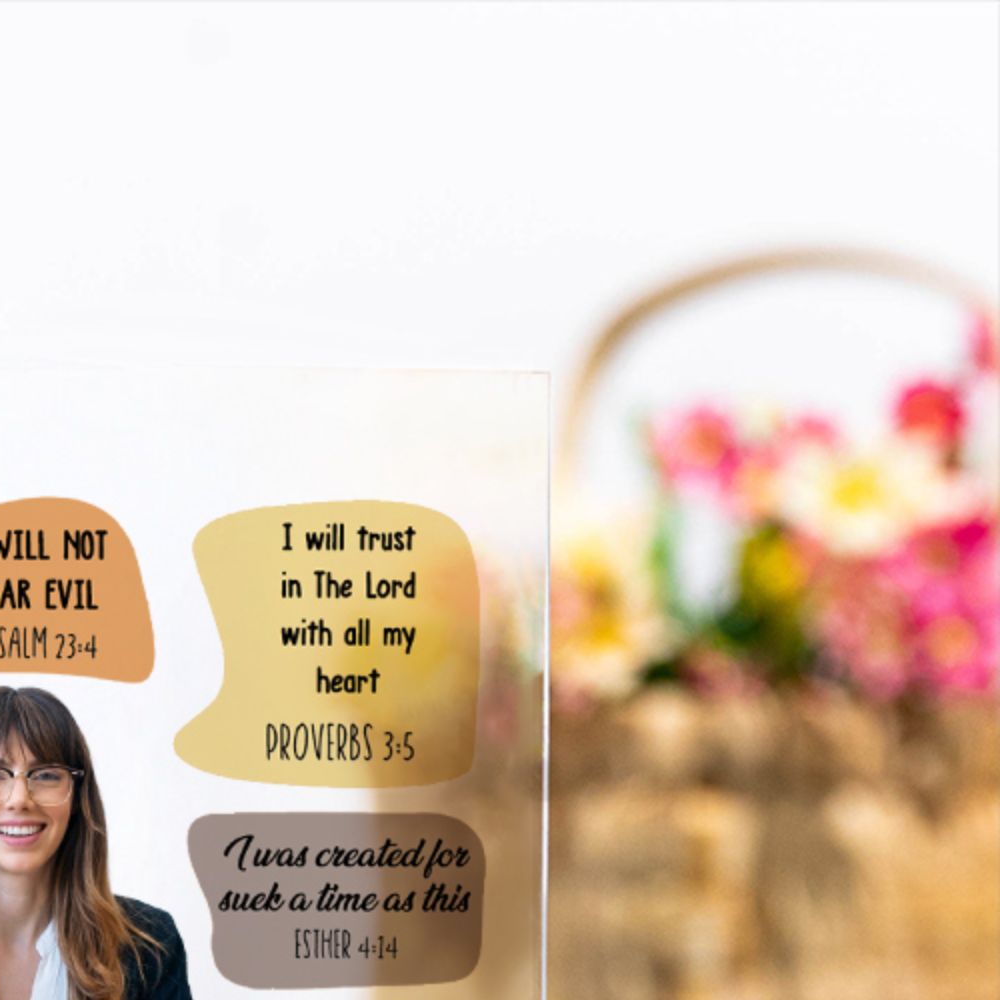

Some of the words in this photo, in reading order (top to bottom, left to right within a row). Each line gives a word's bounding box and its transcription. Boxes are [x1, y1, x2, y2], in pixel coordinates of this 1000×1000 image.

[63, 529, 108, 561] NOT
[282, 522, 293, 551] I
[305, 523, 345, 551] will
[357, 526, 416, 551] trust
[45, 578, 99, 611] EVIL
[281, 571, 302, 598] in
[313, 570, 353, 599] The
[366, 571, 416, 599] Lord
[55, 633, 97, 660] 23:4
[281, 619, 333, 646] with
[343, 618, 371, 647] all
[383, 627, 416, 655] my
[316, 666, 381, 694] heart
[266, 723, 373, 761] PROVERBS
[383, 731, 415, 762] 3:5
[223, 833, 255, 873] I
[252, 845, 310, 868] was
[314, 837, 427, 869] created
[422, 837, 472, 880] for
[287, 892, 314, 912] a
[315, 882, 380, 913] time
[382, 890, 417, 913] as
[421, 881, 473, 915] this
[294, 928, 351, 960] ESTHER
[357, 935, 398, 960] 4:14
